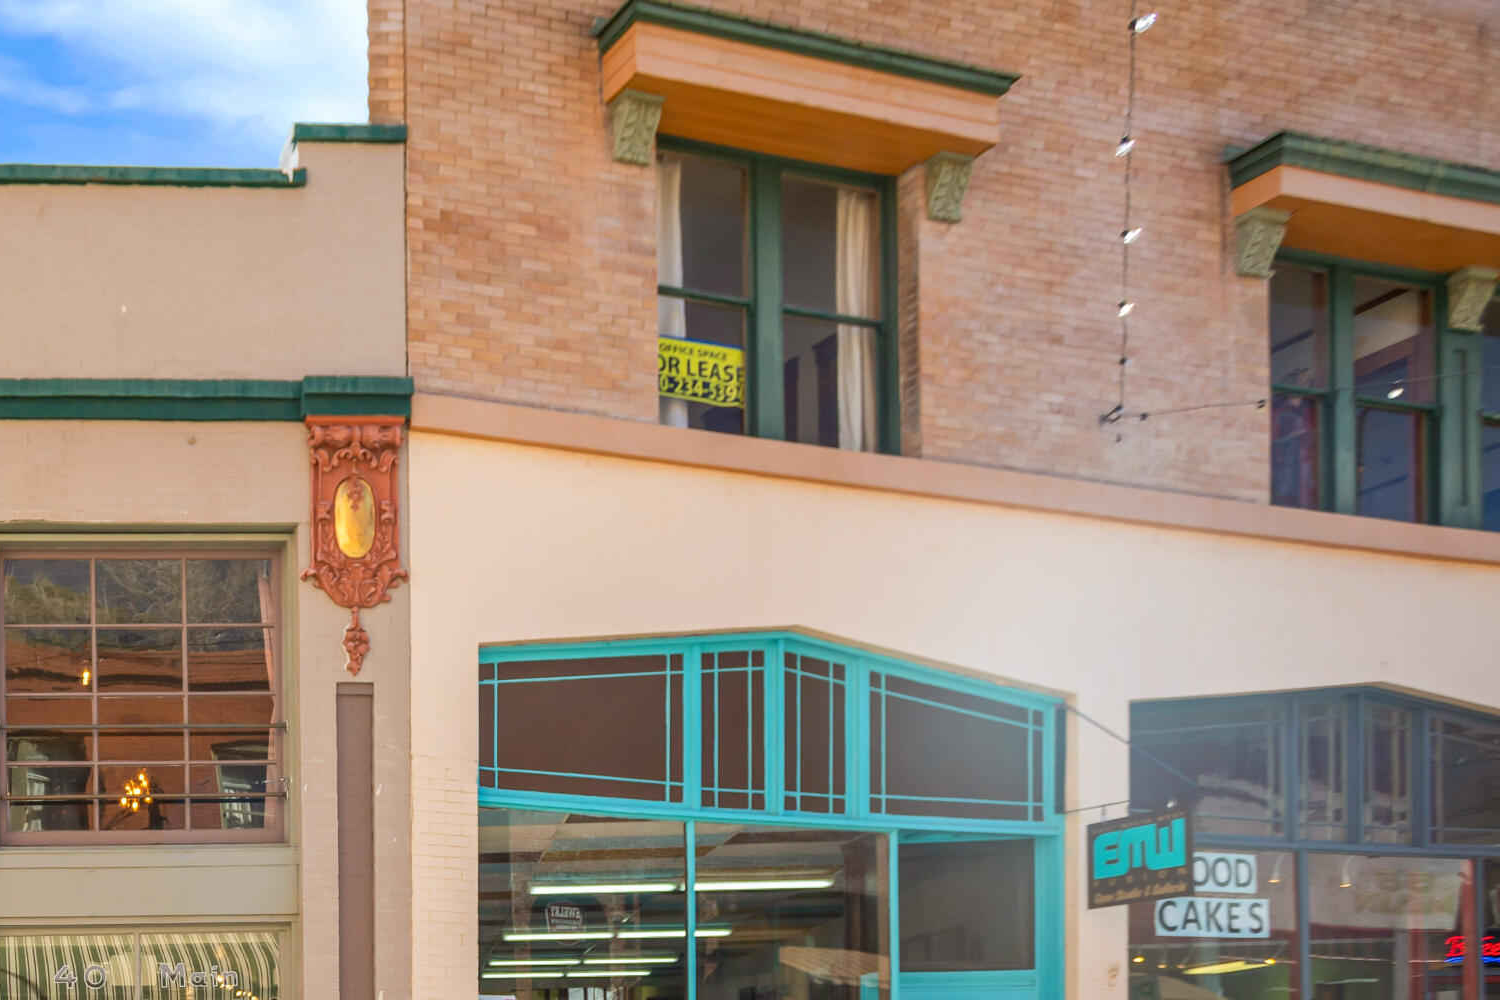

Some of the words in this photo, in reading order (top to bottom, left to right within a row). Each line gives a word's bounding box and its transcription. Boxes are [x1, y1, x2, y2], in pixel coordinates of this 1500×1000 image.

[698, 349, 727, 361] SPACE
[1193, 856, 1253, 888] OOD
[1158, 900, 1264, 934] CAKES
[54, 964, 107, 989] 40
[159, 963, 239, 988] Main
